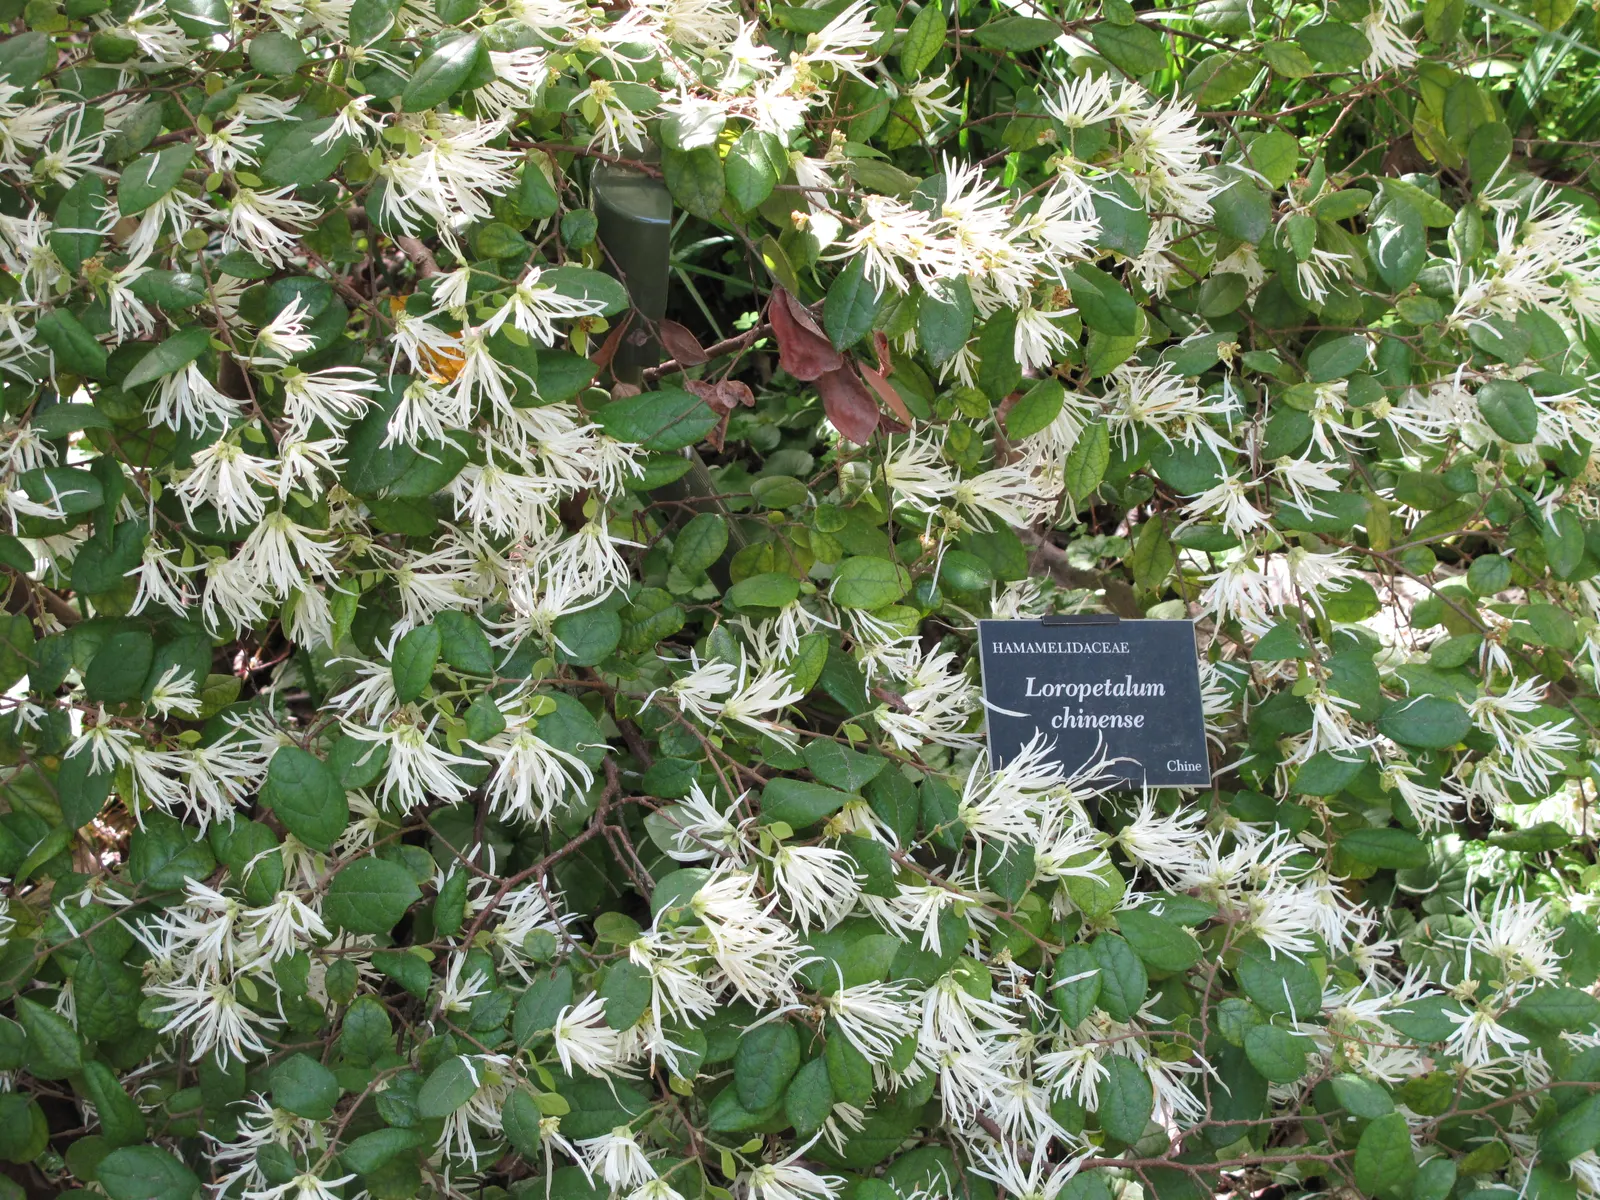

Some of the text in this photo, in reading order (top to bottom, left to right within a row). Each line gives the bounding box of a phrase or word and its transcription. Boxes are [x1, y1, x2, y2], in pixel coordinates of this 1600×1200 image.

[992, 641, 1130, 654] HAMAMELIDACEAE
[1025, 674, 1167, 703] Loropetalum
[1051, 706, 1145, 729] chinense
[1166, 759, 1202, 772] Chine
